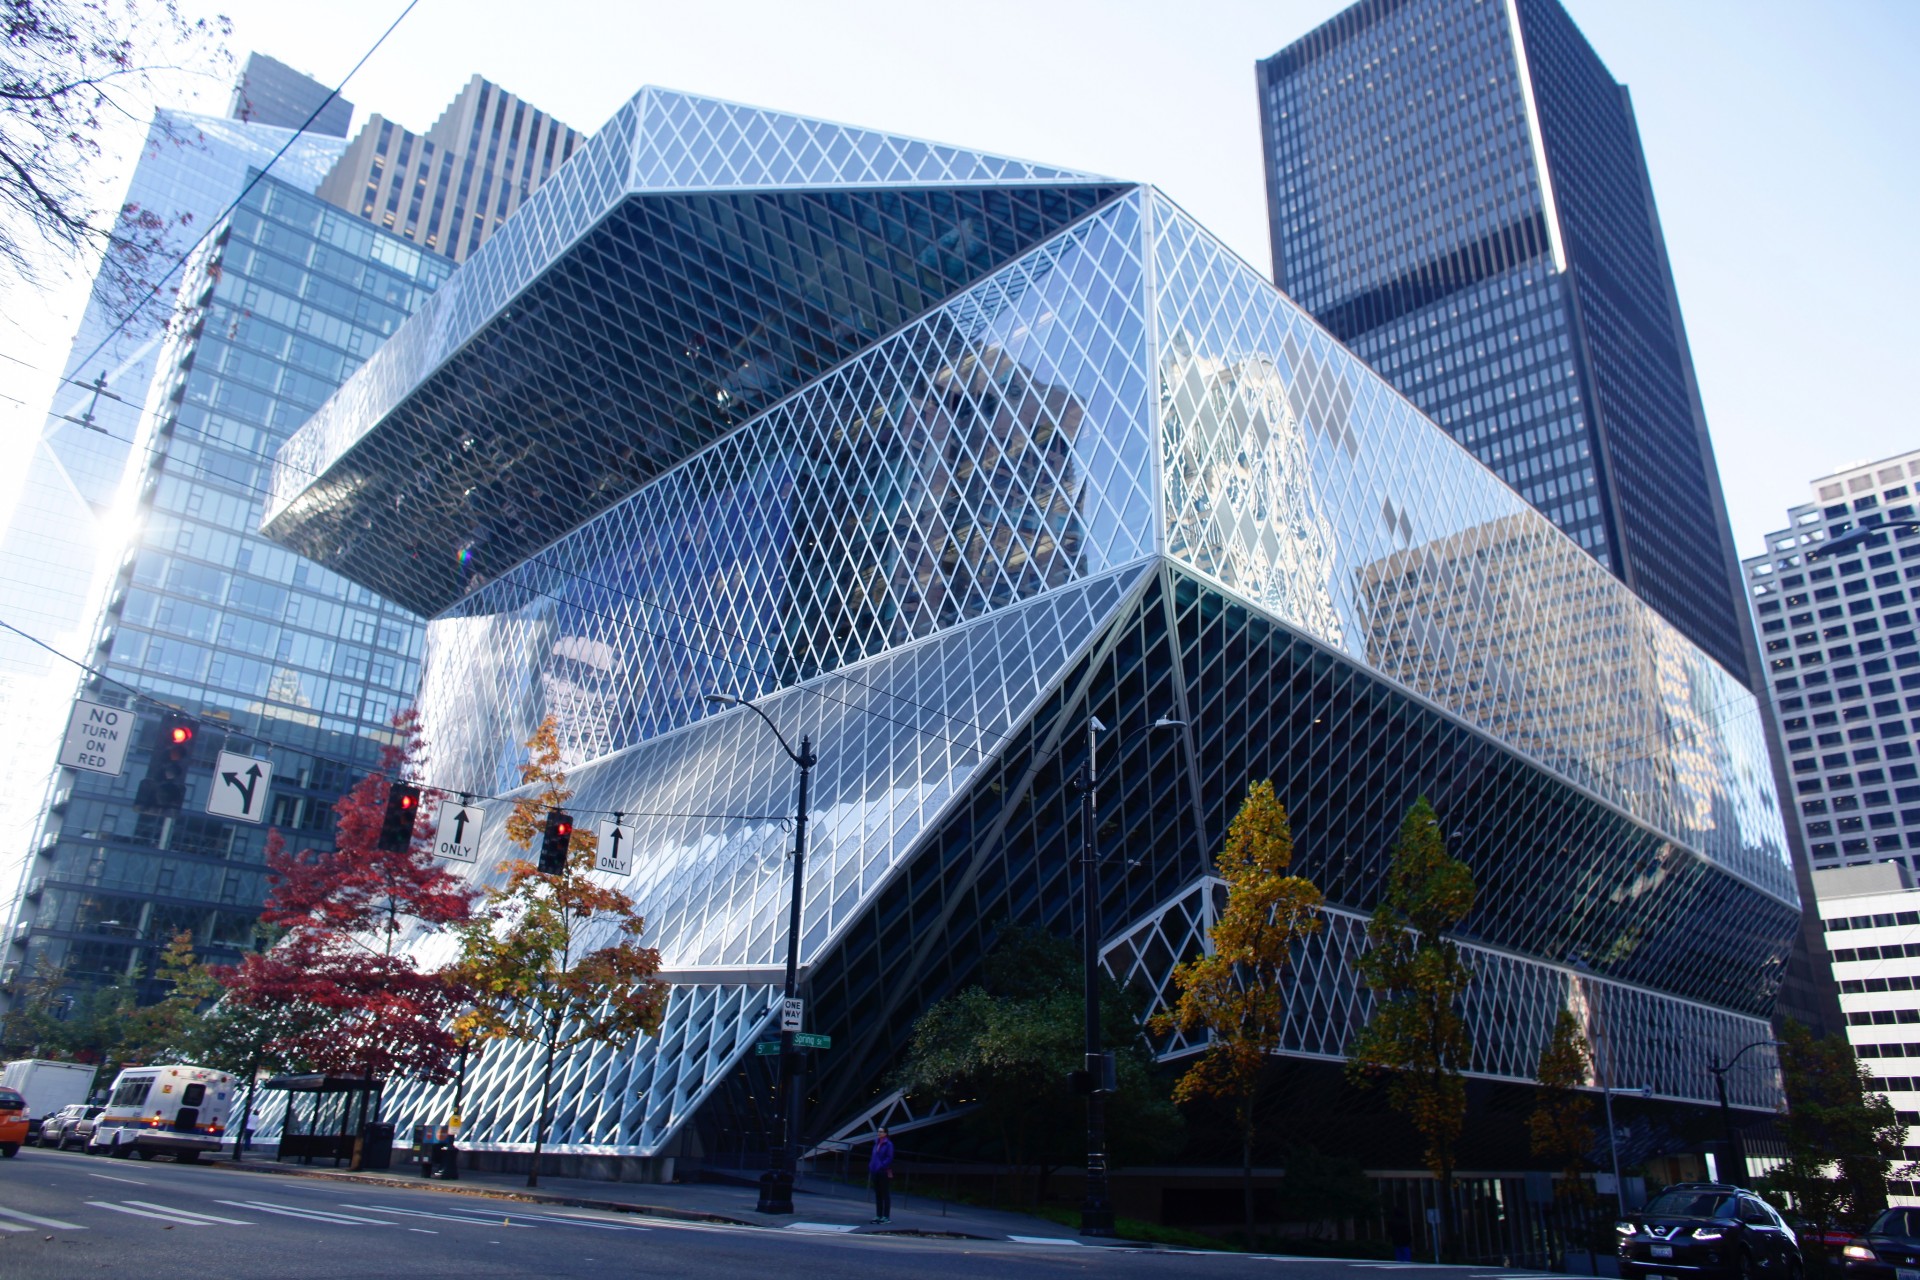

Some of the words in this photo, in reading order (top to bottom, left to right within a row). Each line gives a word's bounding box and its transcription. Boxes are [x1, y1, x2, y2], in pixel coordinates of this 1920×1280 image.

[89, 708, 118, 726] NO
[82, 723, 118, 741] TURN
[86, 739, 106, 753] ON
[78, 752, 106, 768] RED
[441, 842, 471, 857] ONLY
[601, 857, 626, 870] ONLY
[785, 1000, 801, 1010] ONE
[785, 1010, 801, 1018] WAY
[794, 1033, 815, 1047] Spring
